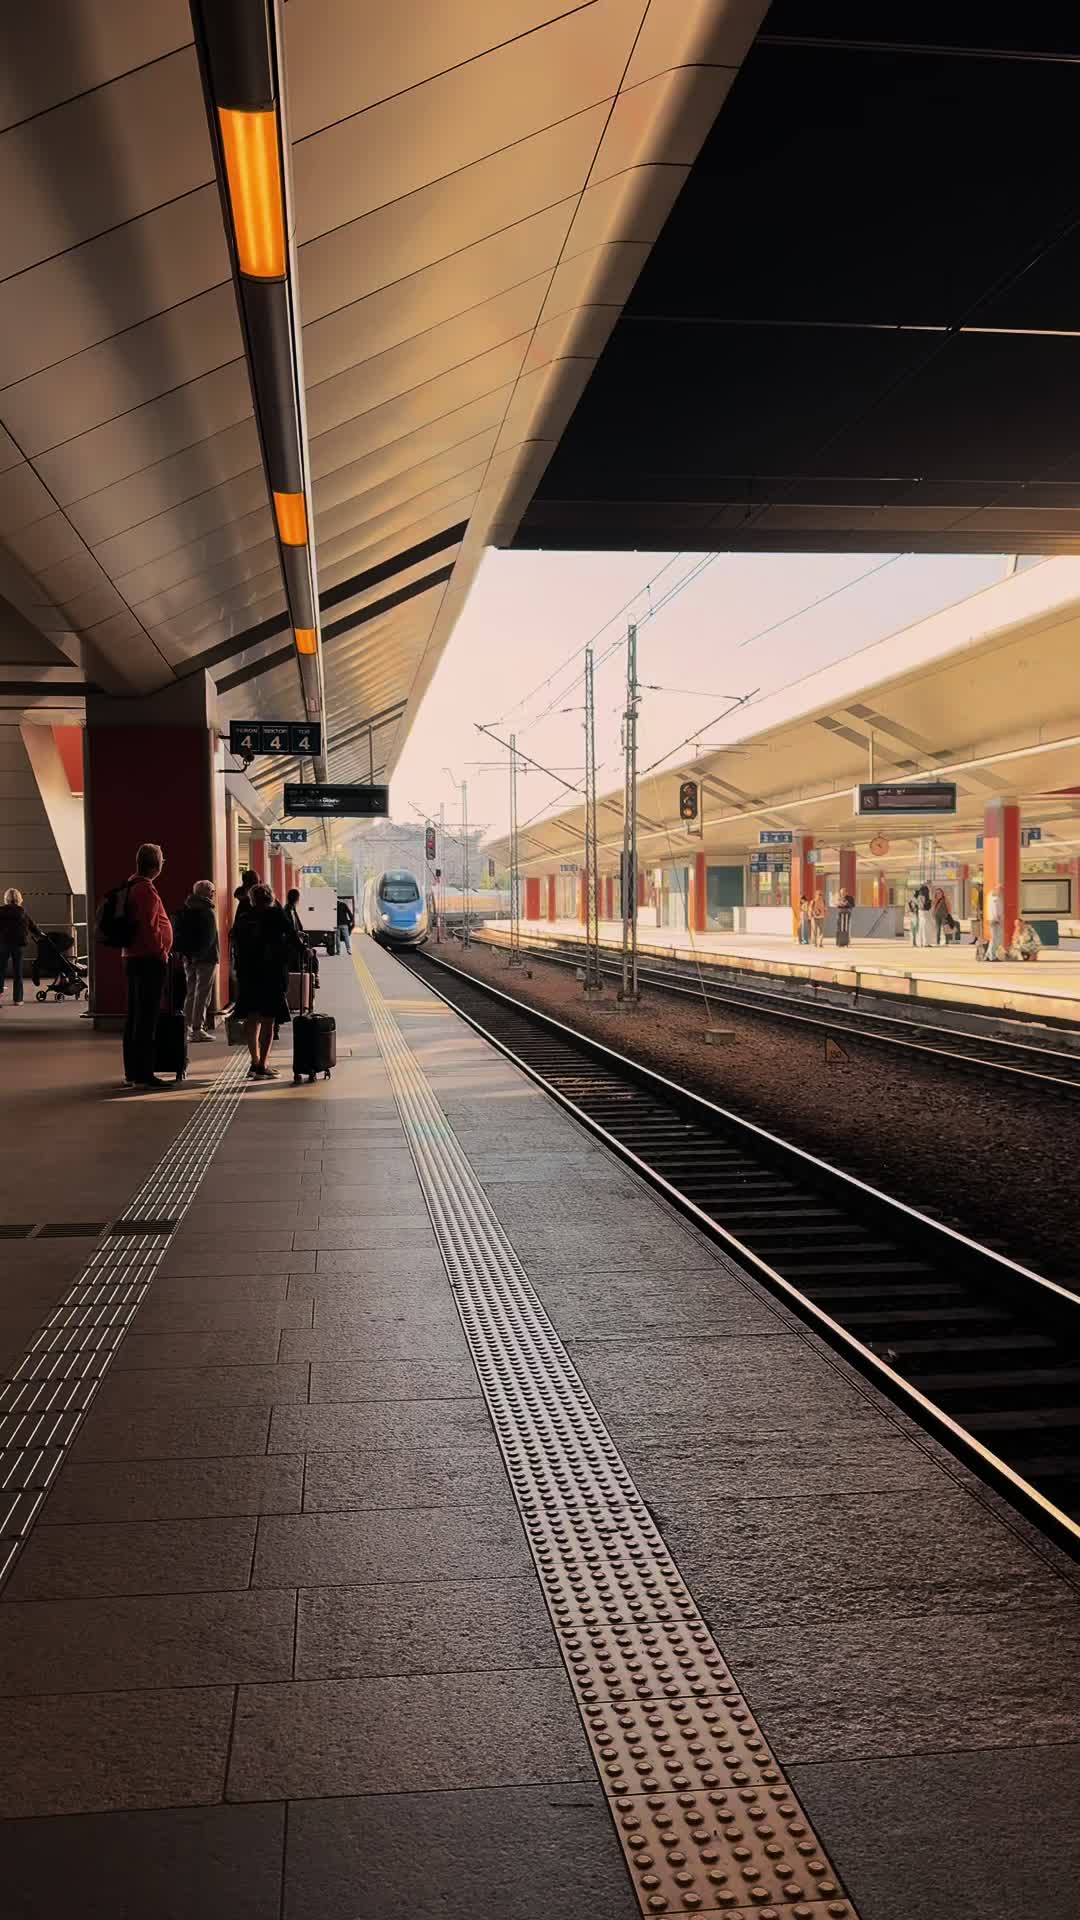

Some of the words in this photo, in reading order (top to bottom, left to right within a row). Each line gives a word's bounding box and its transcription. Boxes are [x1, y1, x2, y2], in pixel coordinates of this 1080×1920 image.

[240, 735, 252, 749] 4
[270, 735, 281, 750] 4
[298, 736, 311, 750] 4
